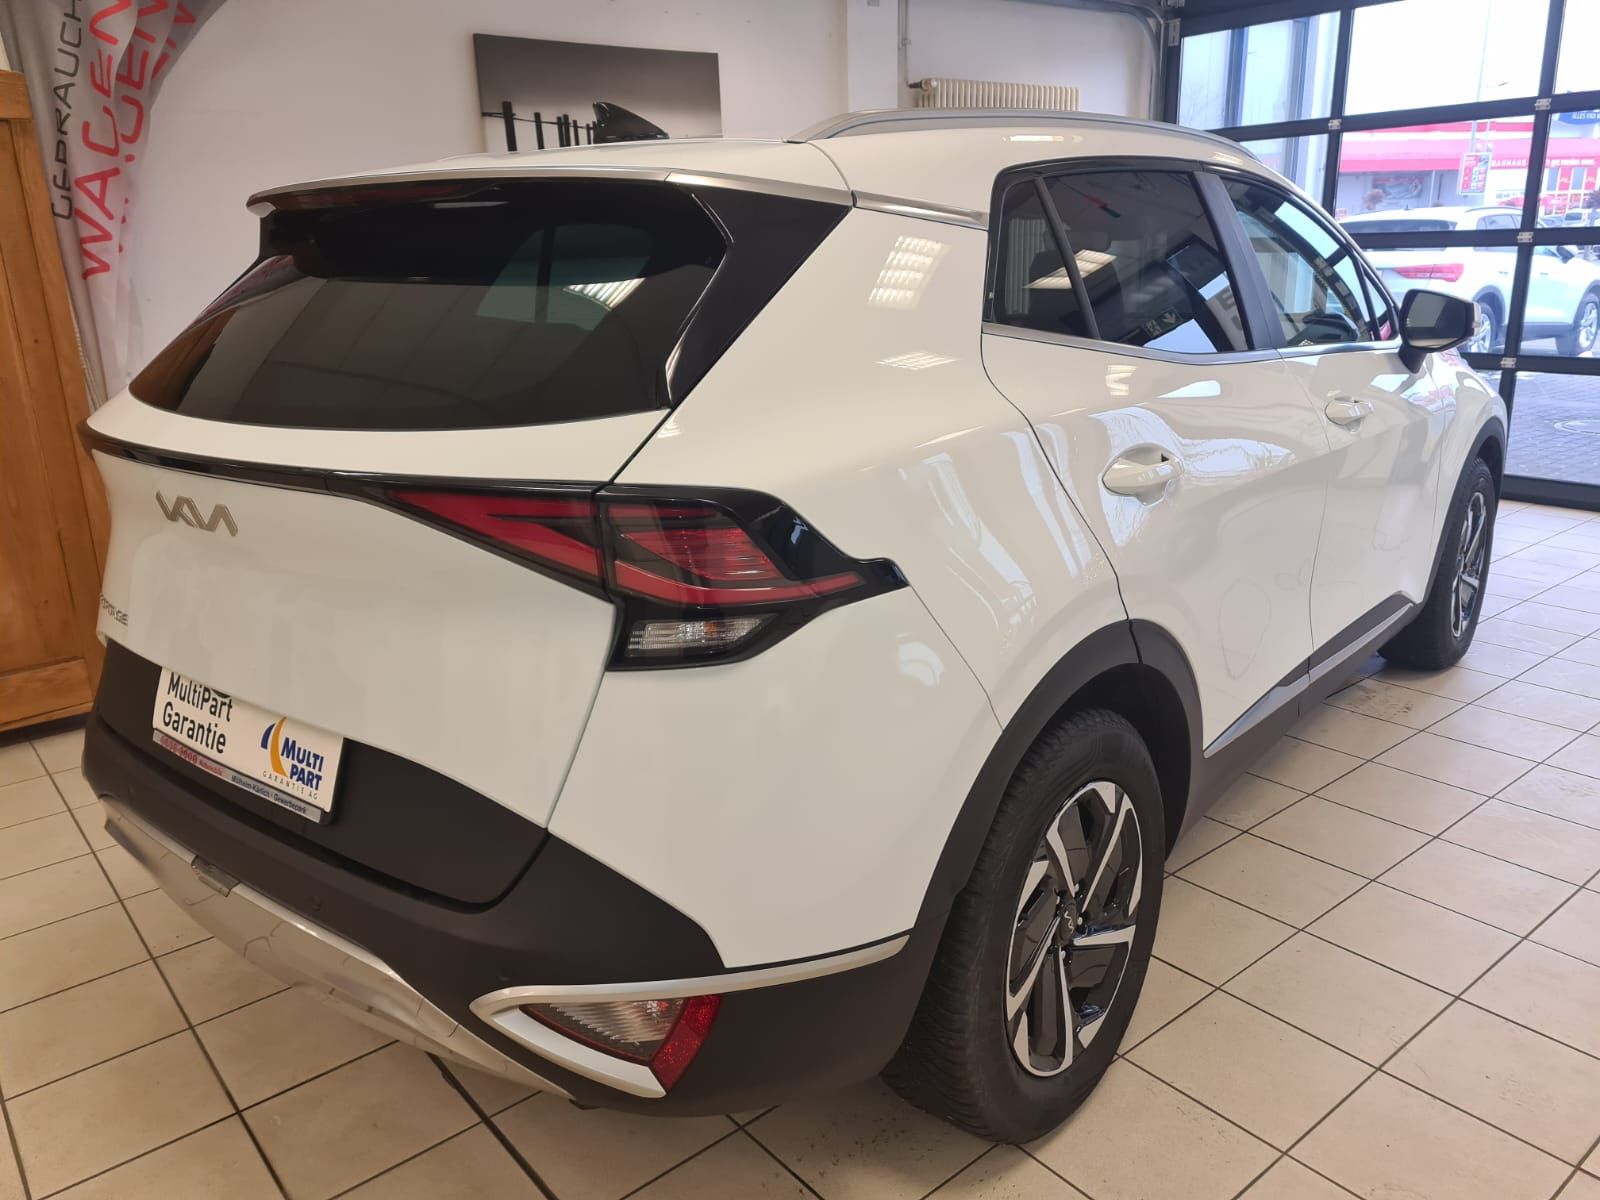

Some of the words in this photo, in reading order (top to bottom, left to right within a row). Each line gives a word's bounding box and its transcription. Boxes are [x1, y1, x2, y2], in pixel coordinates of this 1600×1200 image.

[155, 490, 238, 537] KIA
[167, 672, 233, 722] MultiPart
[162, 701, 226, 754] Garantie
[280, 737, 325, 772] MULTI
[262, 770, 304, 795] GARANTIE
[308, 792, 319, 800] AG
[289, 764, 323, 791] PART
